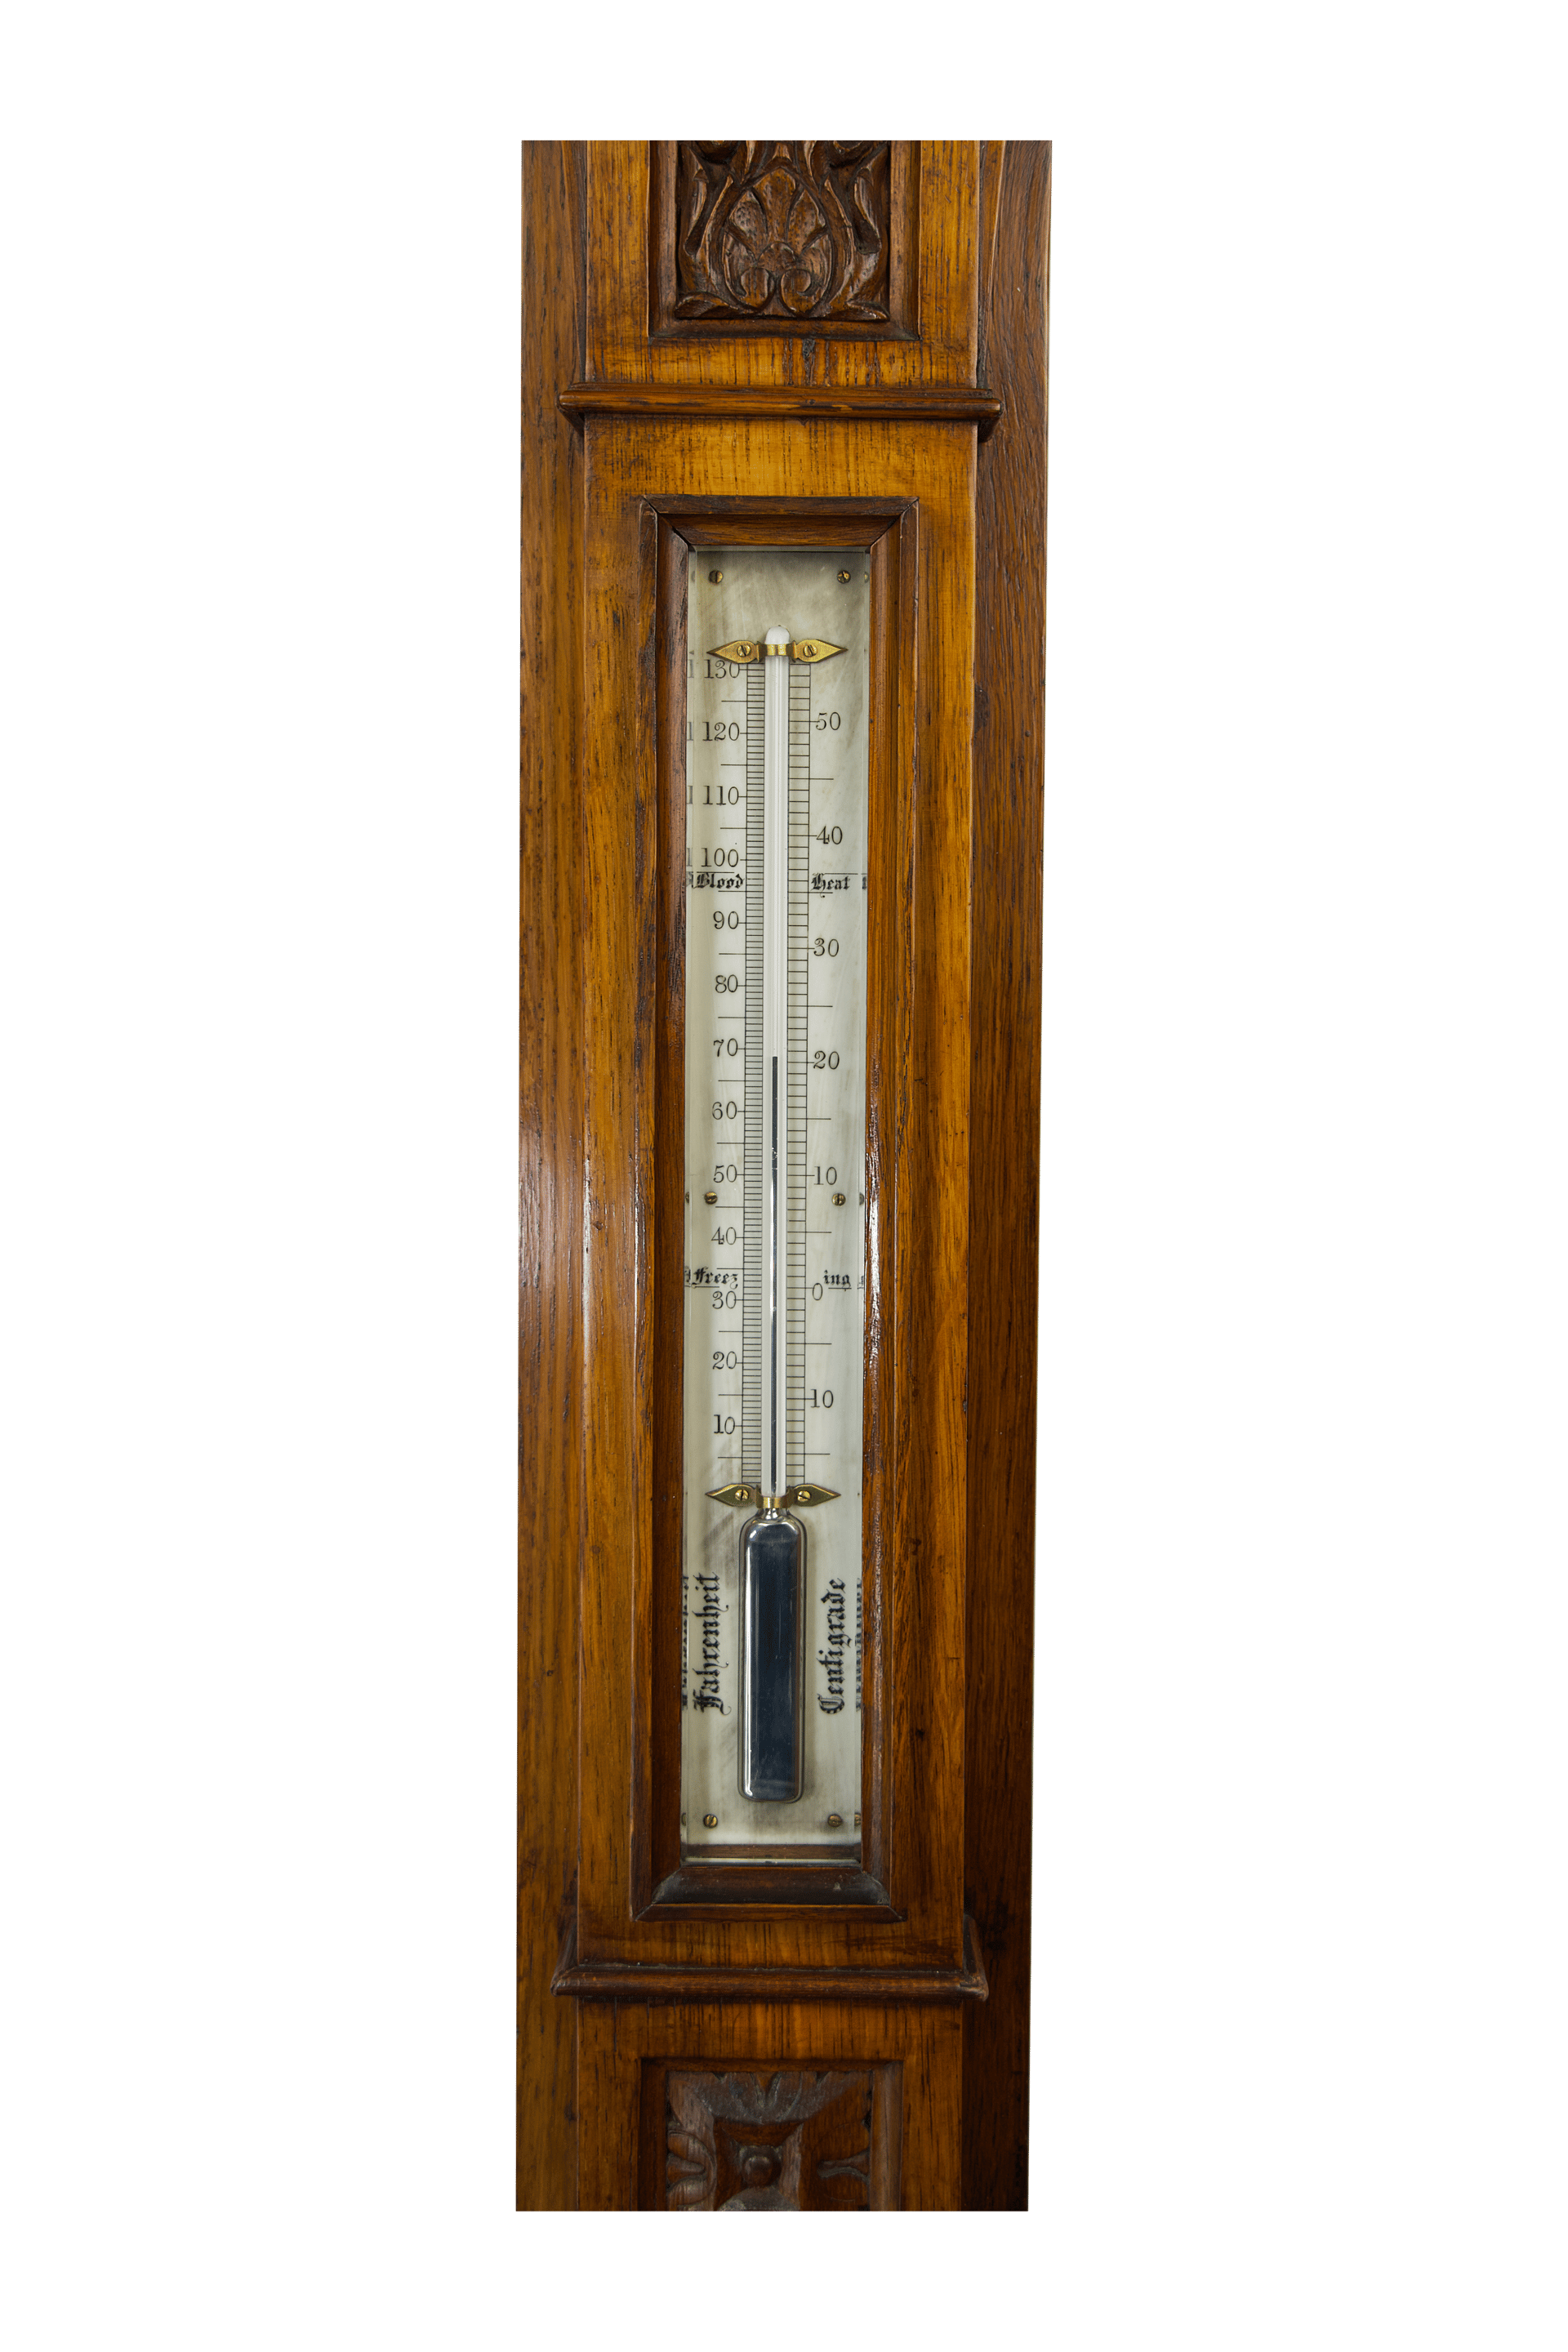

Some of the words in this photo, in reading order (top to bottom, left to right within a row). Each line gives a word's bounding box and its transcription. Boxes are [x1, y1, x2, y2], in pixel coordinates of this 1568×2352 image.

[704, 660, 739, 679] 130
[816, 712, 840, 730] 50
[702, 722, 739, 742] 120
[703, 786, 739, 805] 110
[817, 826, 843, 844] 40
[701, 848, 739, 867] 100
[695, 873, 745, 889] Blood
[811, 873, 850, 898] Heat
[713, 911, 739, 929] 90
[813, 938, 839, 956] 30
[715, 974, 738, 993] 80
[713, 1038, 738, 1057] 70
[813, 1050, 840, 1070] 20
[712, 1102, 737, 1120] 60
[713, 1165, 737, 1183] 50
[813, 1166, 837, 1185] 10
[711, 1227, 736, 1245] 40
[824, 1270, 851, 1291] ing
[712, 1290, 737, 1309] 30
[812, 1282, 823, 1300] 0
[712, 1351, 737, 1370] 20
[810, 1389, 833, 1408] 10
[714, 1414, 735, 1435] 10
[693, 1572, 732, 1715] Fahrenheit
[817, 1578, 852, 1714] Centigrade
